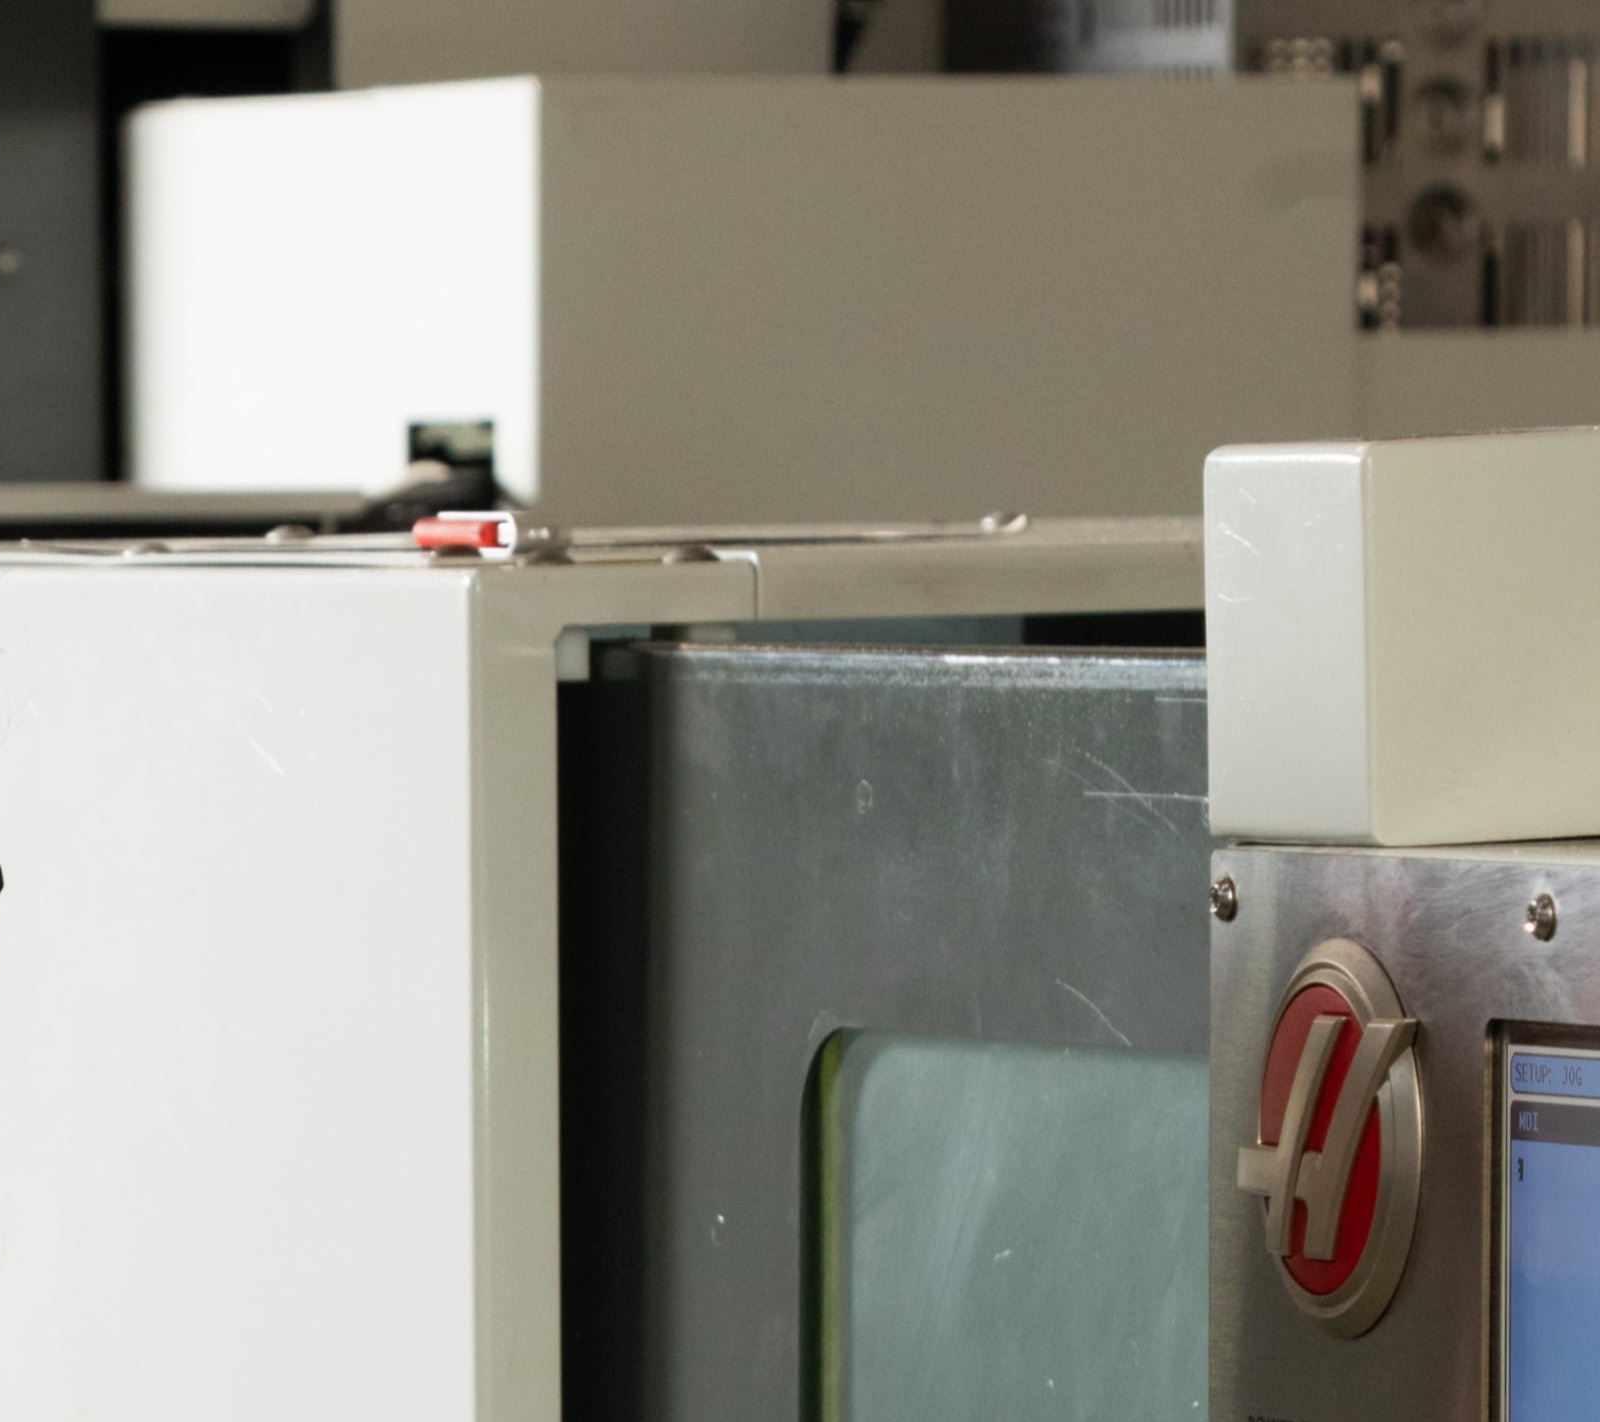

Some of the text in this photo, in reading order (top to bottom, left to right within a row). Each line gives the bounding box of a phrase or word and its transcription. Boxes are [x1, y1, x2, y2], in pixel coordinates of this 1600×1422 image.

[1515, 1062, 1582, 1086] SETUP: JOG
[1519, 1111, 1539, 1132] MDI
